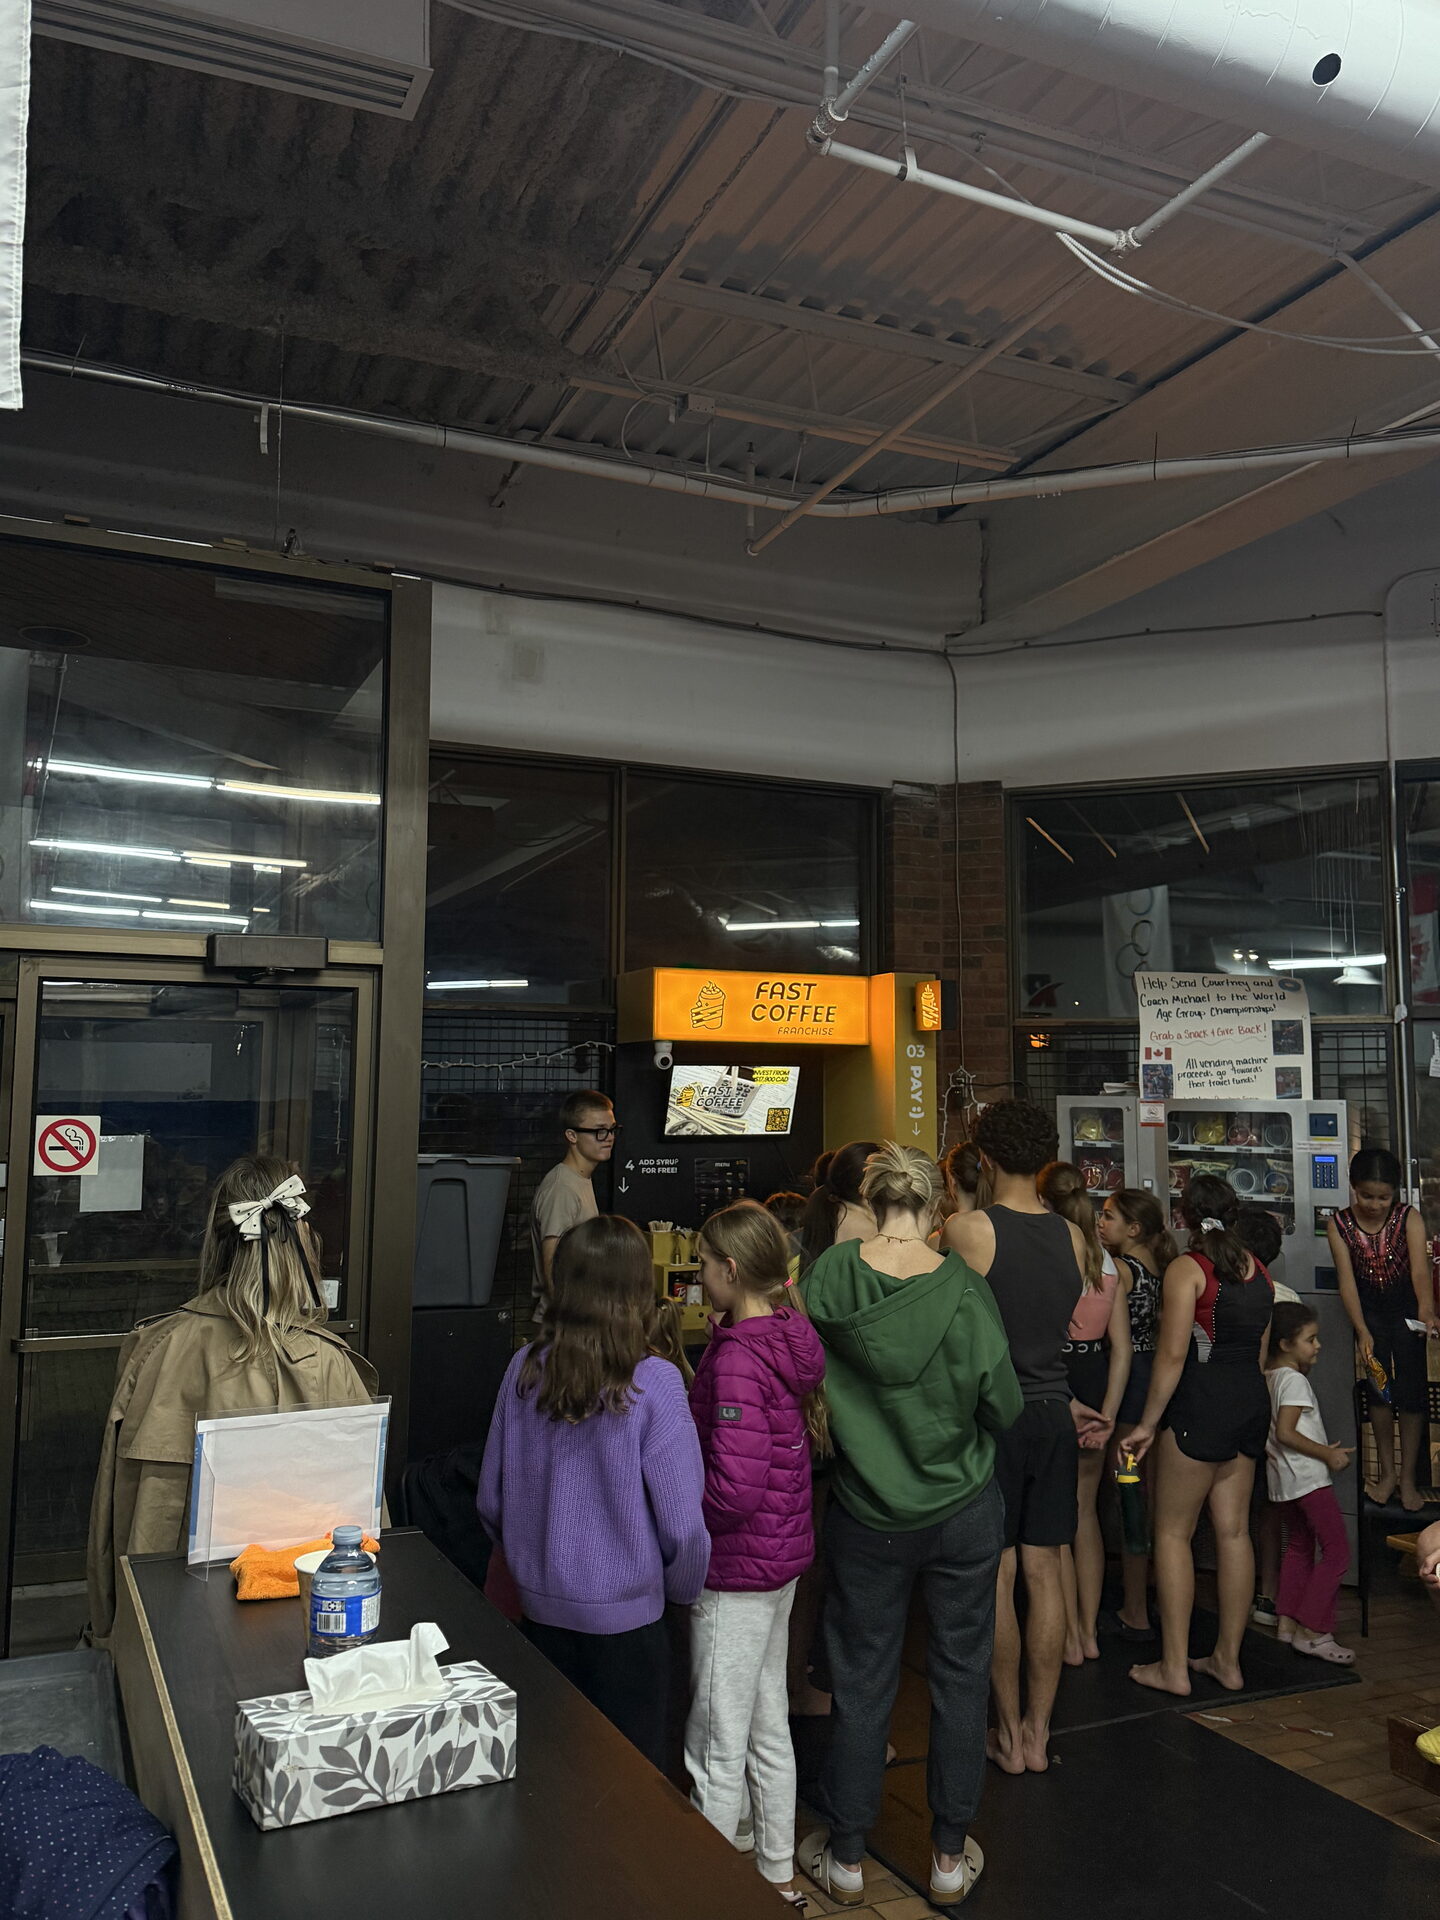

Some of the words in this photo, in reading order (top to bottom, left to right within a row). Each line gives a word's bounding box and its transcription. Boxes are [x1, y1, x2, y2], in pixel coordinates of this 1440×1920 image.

[1142, 976, 1168, 990] Help
[1171, 976, 1197, 989] Send
[1202, 976, 1251, 992] Courtney
[1253, 979, 1274, 987] and
[755, 981, 817, 1001] FAST
[1140, 993, 1169, 1007] Coach
[1172, 993, 1210, 1004] Michael
[1217, 993, 1227, 1001] to
[1231, 993, 1248, 1001] the
[1253, 992, 1287, 1001] World
[751, 1004, 837, 1023] COFFEE
[1156, 1008, 1173, 1022] Age
[1176, 1007, 1206, 1020] Group
[777, 1026, 834, 1036] FRANCHISE
[1150, 1030, 1175, 1041] Grab
[1184, 1029, 1209, 1040] Snack
[1216, 1027, 1234, 1037] Give
[906, 1044, 926, 1058] 03
[1185, 1058, 1198, 1069] All
[1199, 1059, 1234, 1069] vending
[1235, 1057, 1268, 1066] machine
[1177, 1070, 1213, 1081] proceeds
[1216, 1070, 1227, 1080] go
[910, 1065, 923, 1104] PAY
[1188, 1080, 1206, 1088] their
[1208, 1079, 1231, 1087] travel
[700, 1086, 733, 1095] FAST
[696, 1097, 744, 1107] COFFEE
[625, 1160, 636, 1171] 4
[656, 1158, 680, 1166] SYRUP
